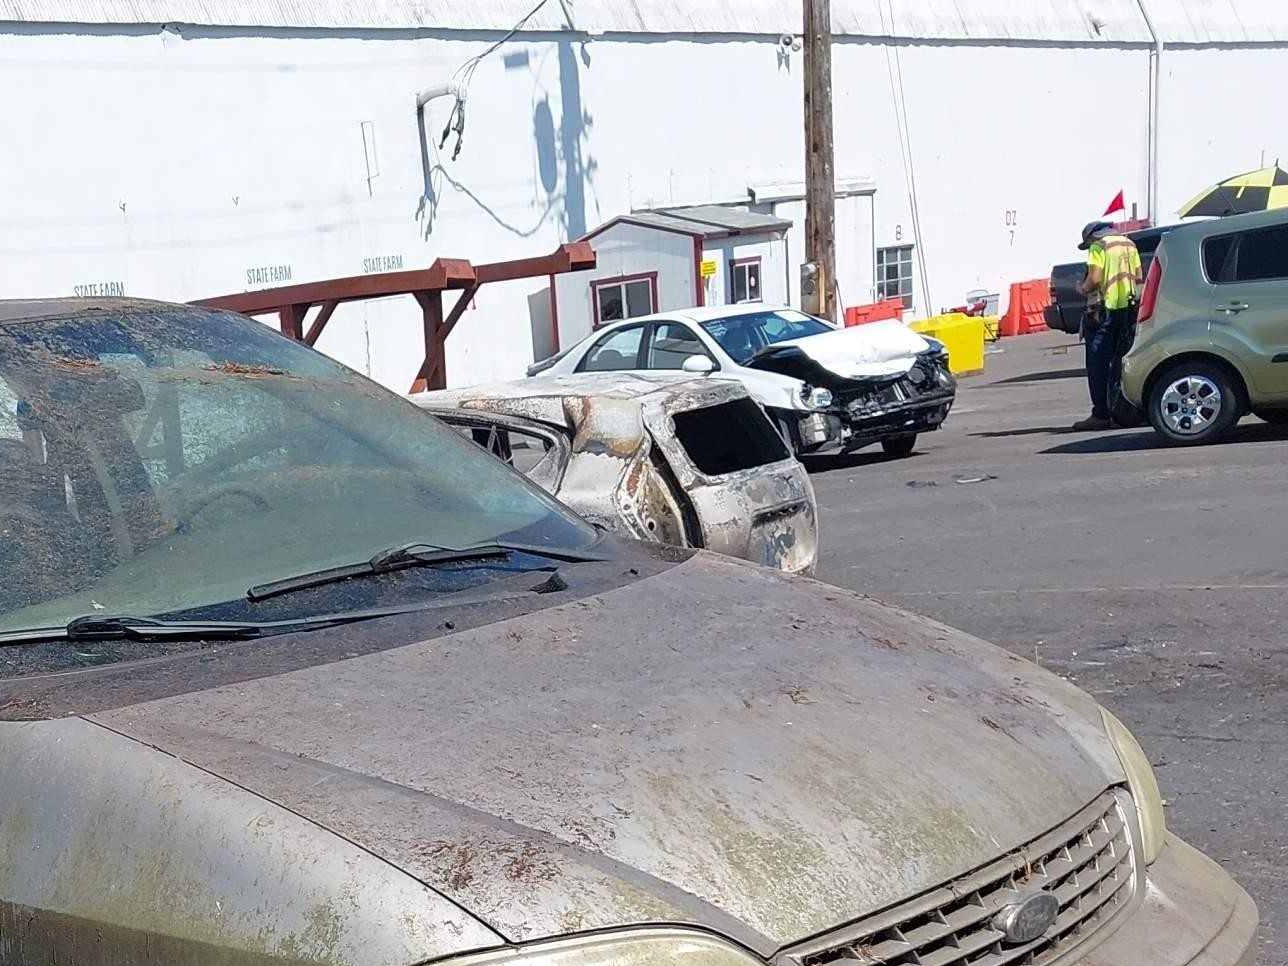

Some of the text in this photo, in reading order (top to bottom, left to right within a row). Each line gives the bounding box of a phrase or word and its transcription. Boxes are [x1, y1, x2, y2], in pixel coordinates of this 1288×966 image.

[363, 254, 403, 273] STATE FARM
[247, 264, 292, 284] STATE FARM
